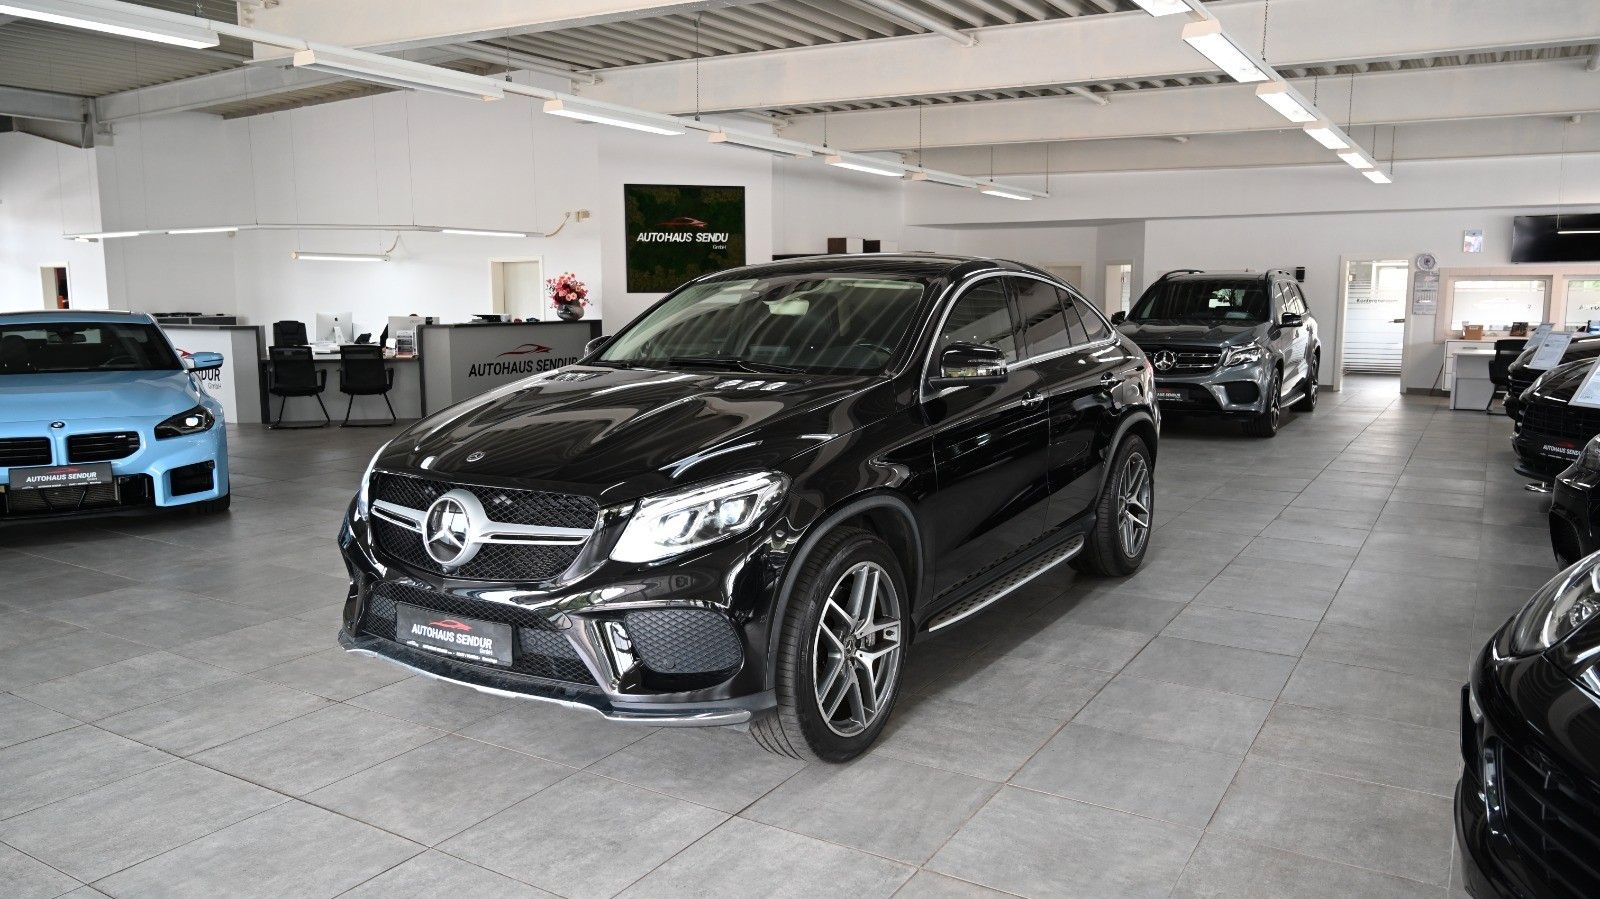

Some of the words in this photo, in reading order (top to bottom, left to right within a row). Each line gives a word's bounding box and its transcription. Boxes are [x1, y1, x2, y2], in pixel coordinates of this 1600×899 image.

[636, 232, 693, 243] AUTOHAUS
[468, 360, 534, 378] AUTOHAUS
[25, 473, 67, 483] AUTOHAUS
[67, 471, 97, 480] SENDUR
[411, 623, 455, 643] AUTOHAUS
[455, 633, 493, 650] SENDUR
